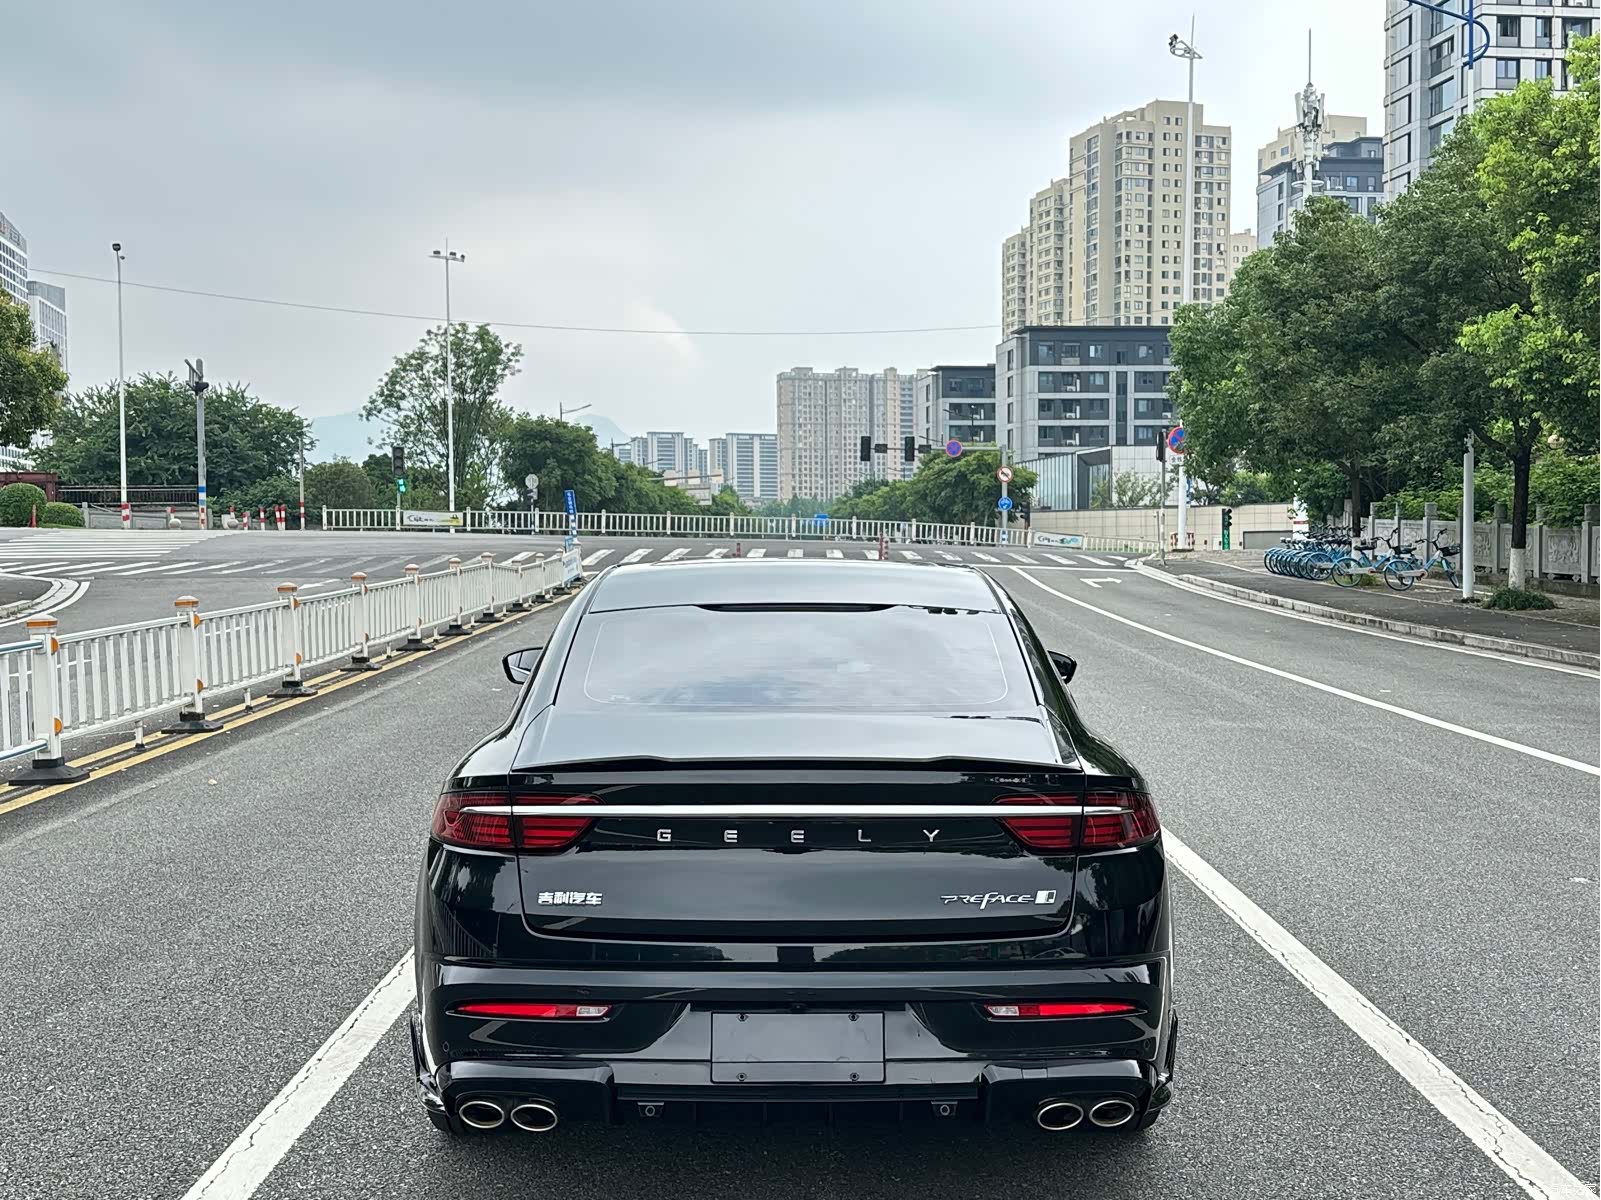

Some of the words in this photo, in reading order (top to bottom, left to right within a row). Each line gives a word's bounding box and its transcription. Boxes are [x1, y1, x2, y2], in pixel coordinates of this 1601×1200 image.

[657, 829, 940, 842] GEELY
[538, 891, 603, 905] 吉利汽车
[941, 892, 1034, 909] PREFACE
